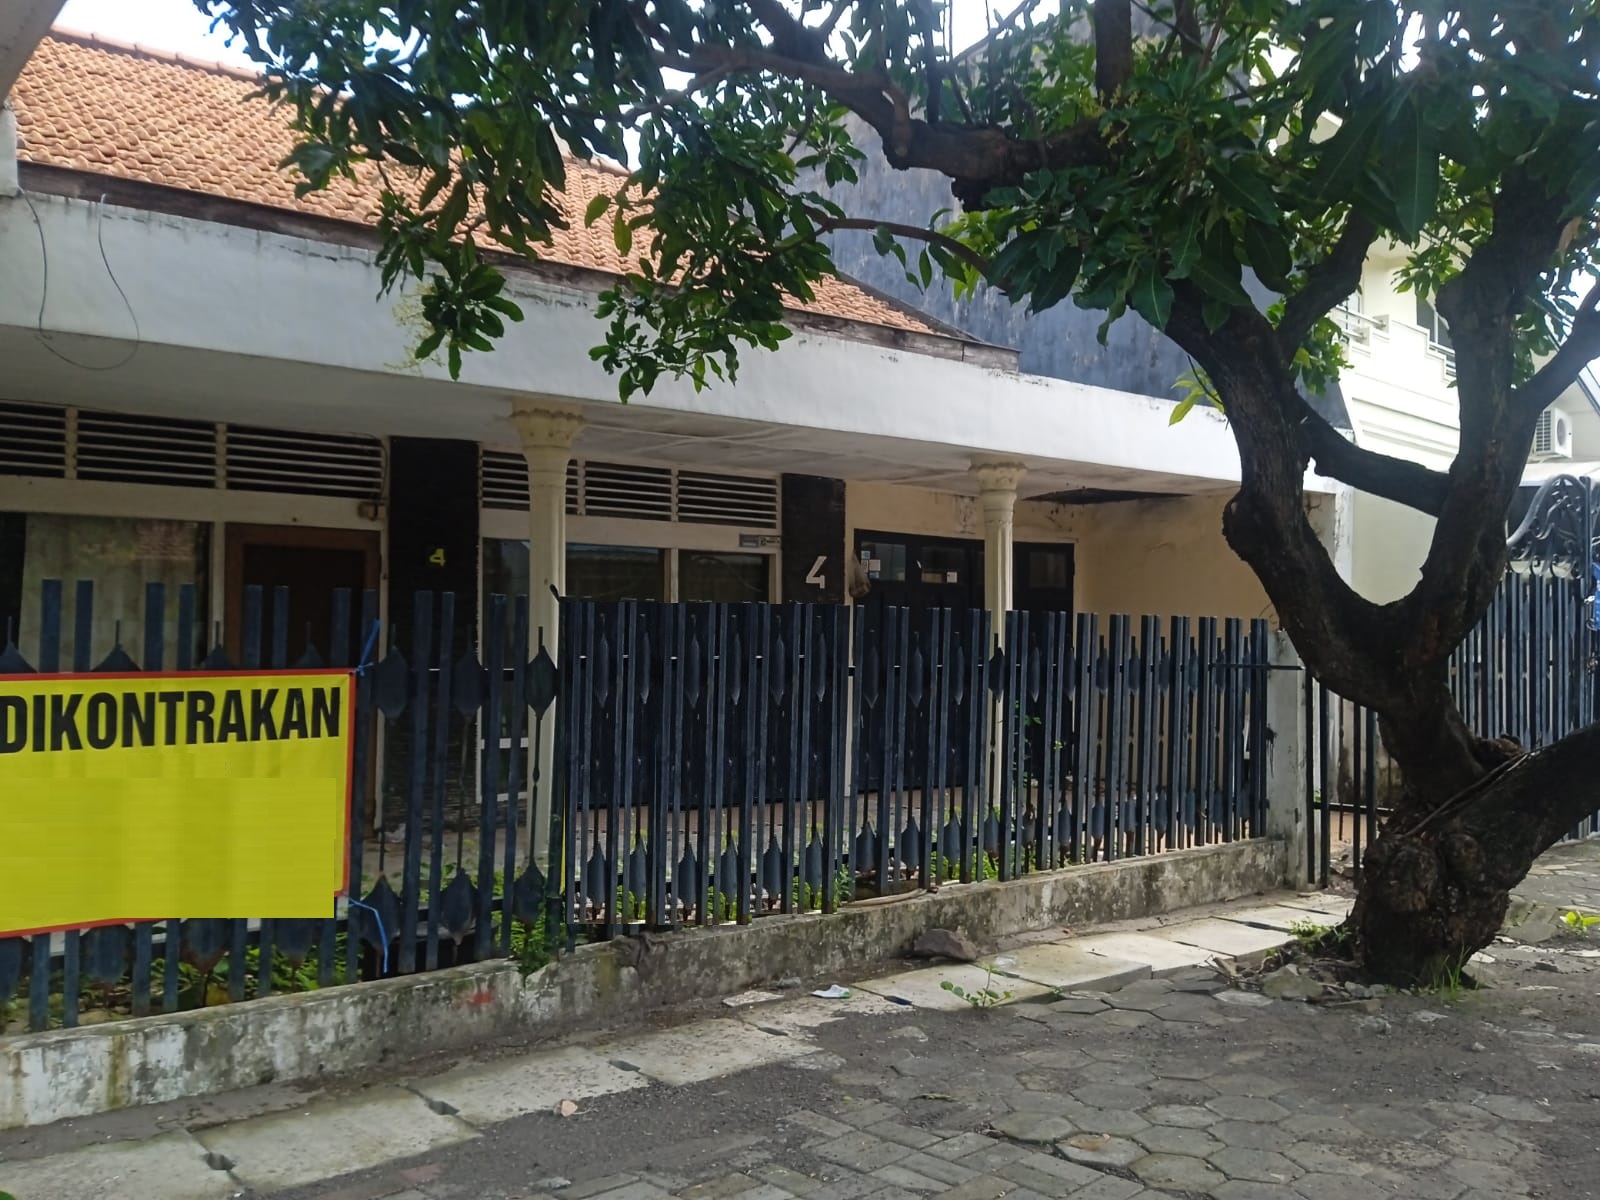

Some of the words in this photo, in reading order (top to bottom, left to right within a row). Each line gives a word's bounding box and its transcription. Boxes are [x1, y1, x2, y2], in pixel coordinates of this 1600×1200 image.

[430, 548, 446, 567] 4
[805, 555, 827, 589] 4
[0, 686, 341, 754] DIKONTRAKAN
